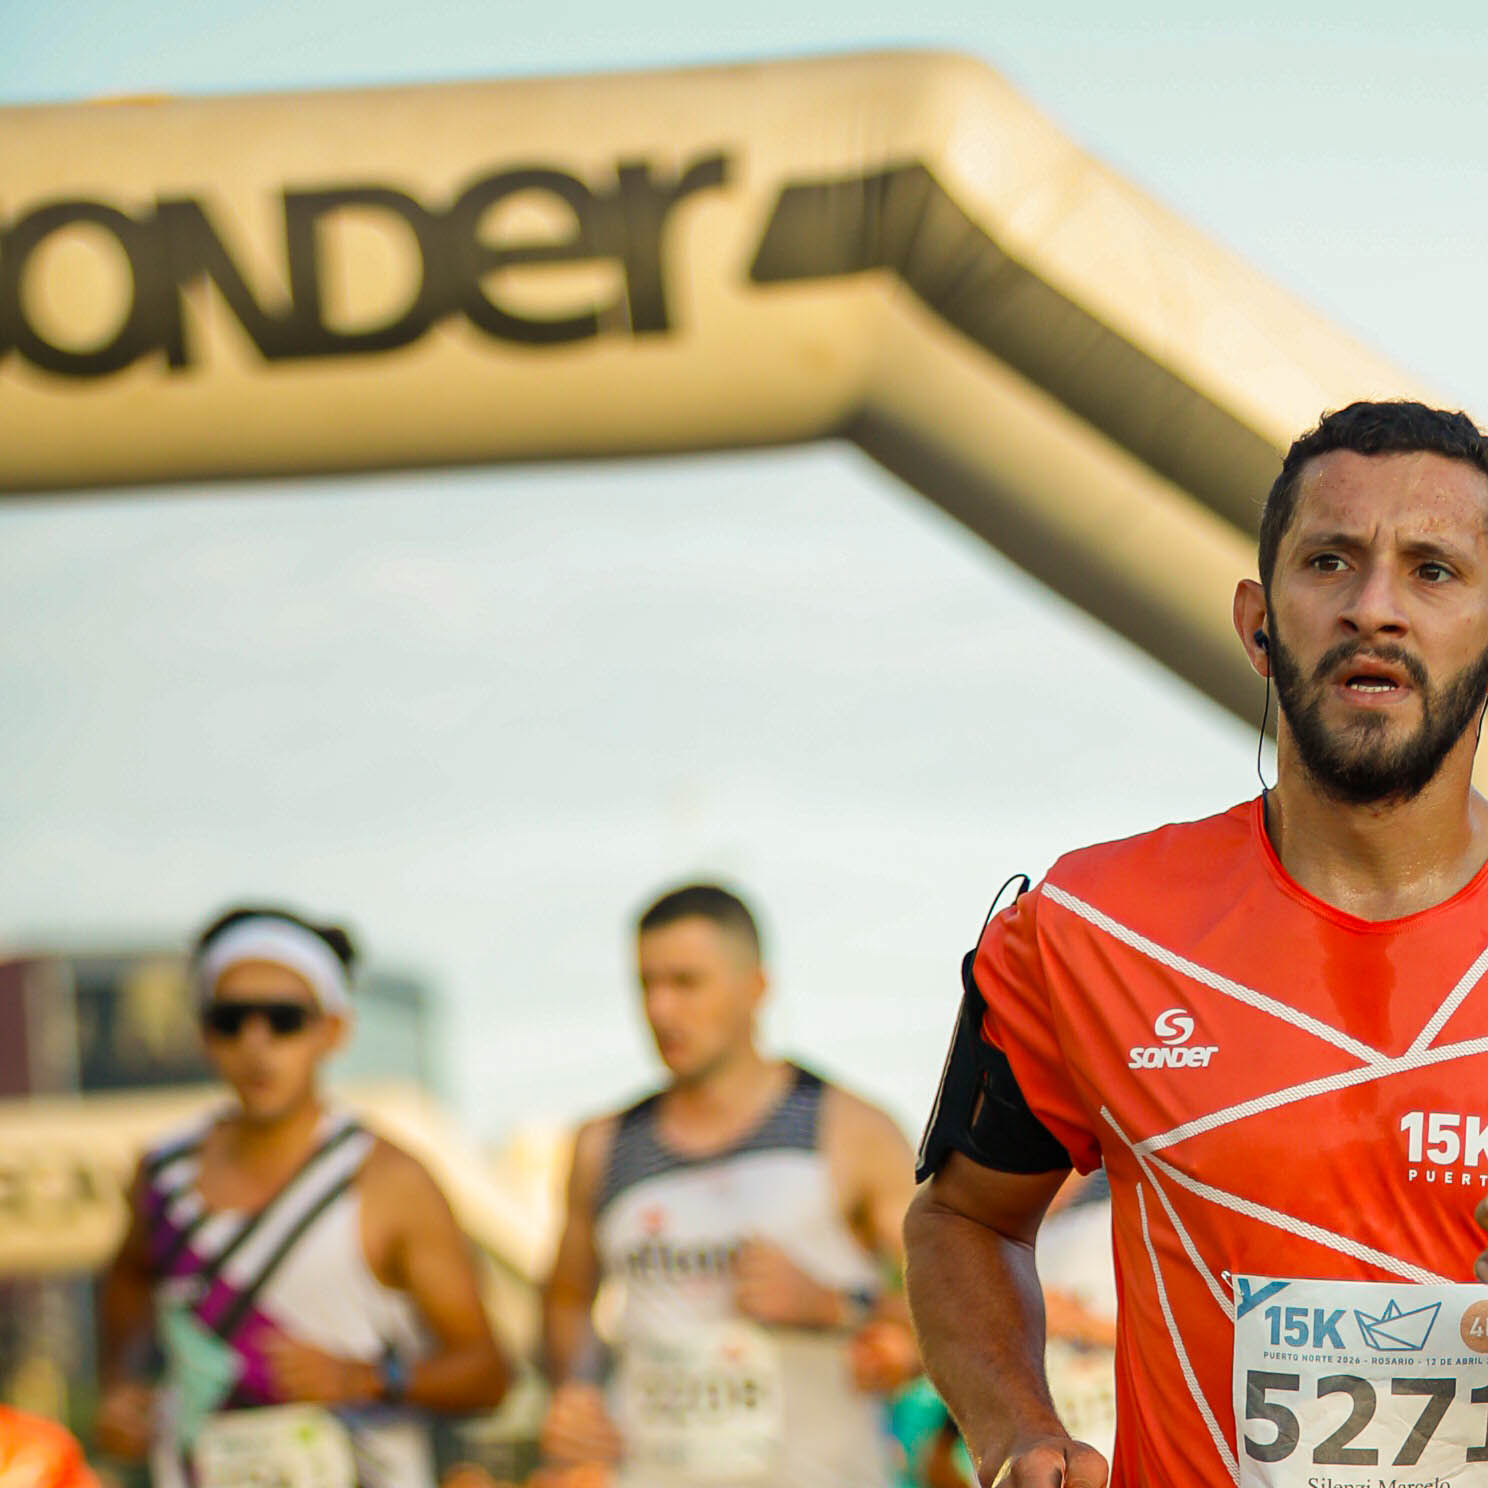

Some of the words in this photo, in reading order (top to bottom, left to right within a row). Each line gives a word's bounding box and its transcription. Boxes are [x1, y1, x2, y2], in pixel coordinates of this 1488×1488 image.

[1264, 1305, 1347, 1349] 15K
[1263, 1351, 1299, 1361] PUERTO
[1302, 1354, 1334, 1363] NORTE
[1371, 1357, 1415, 1366] ROSARIO
[1440, 1358, 1453, 1366] DE
[1455, 1357, 1484, 1366] ABRIL
